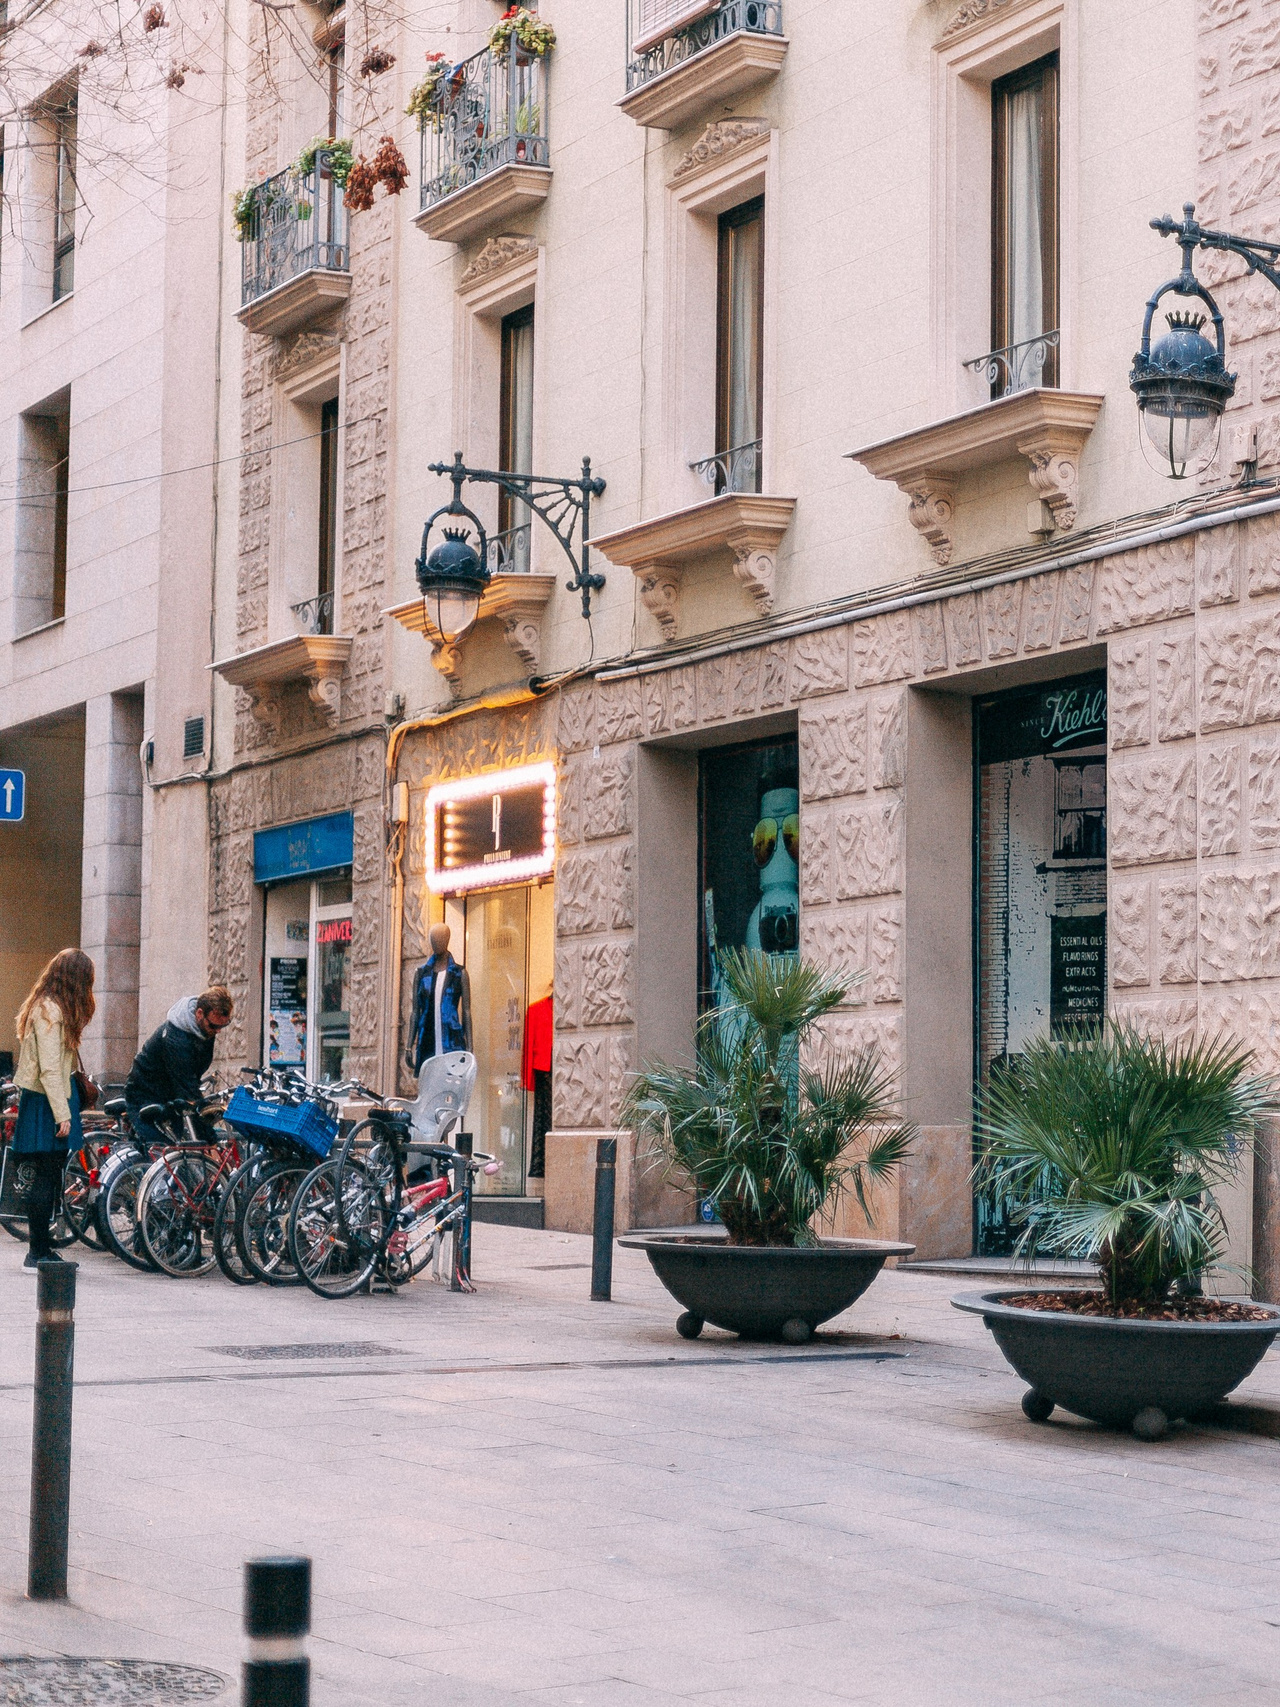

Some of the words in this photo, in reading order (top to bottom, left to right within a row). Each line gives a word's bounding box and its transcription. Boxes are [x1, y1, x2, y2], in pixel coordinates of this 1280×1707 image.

[1060, 936, 1088, 947] ESSENTIAL
[1090, 936, 1103, 946] OILS
[1063, 951, 1099, 962] FLAVORINGS
[1065, 967, 1096, 977] EXTRACTS
[1068, 997, 1099, 1007] MEDICINES
